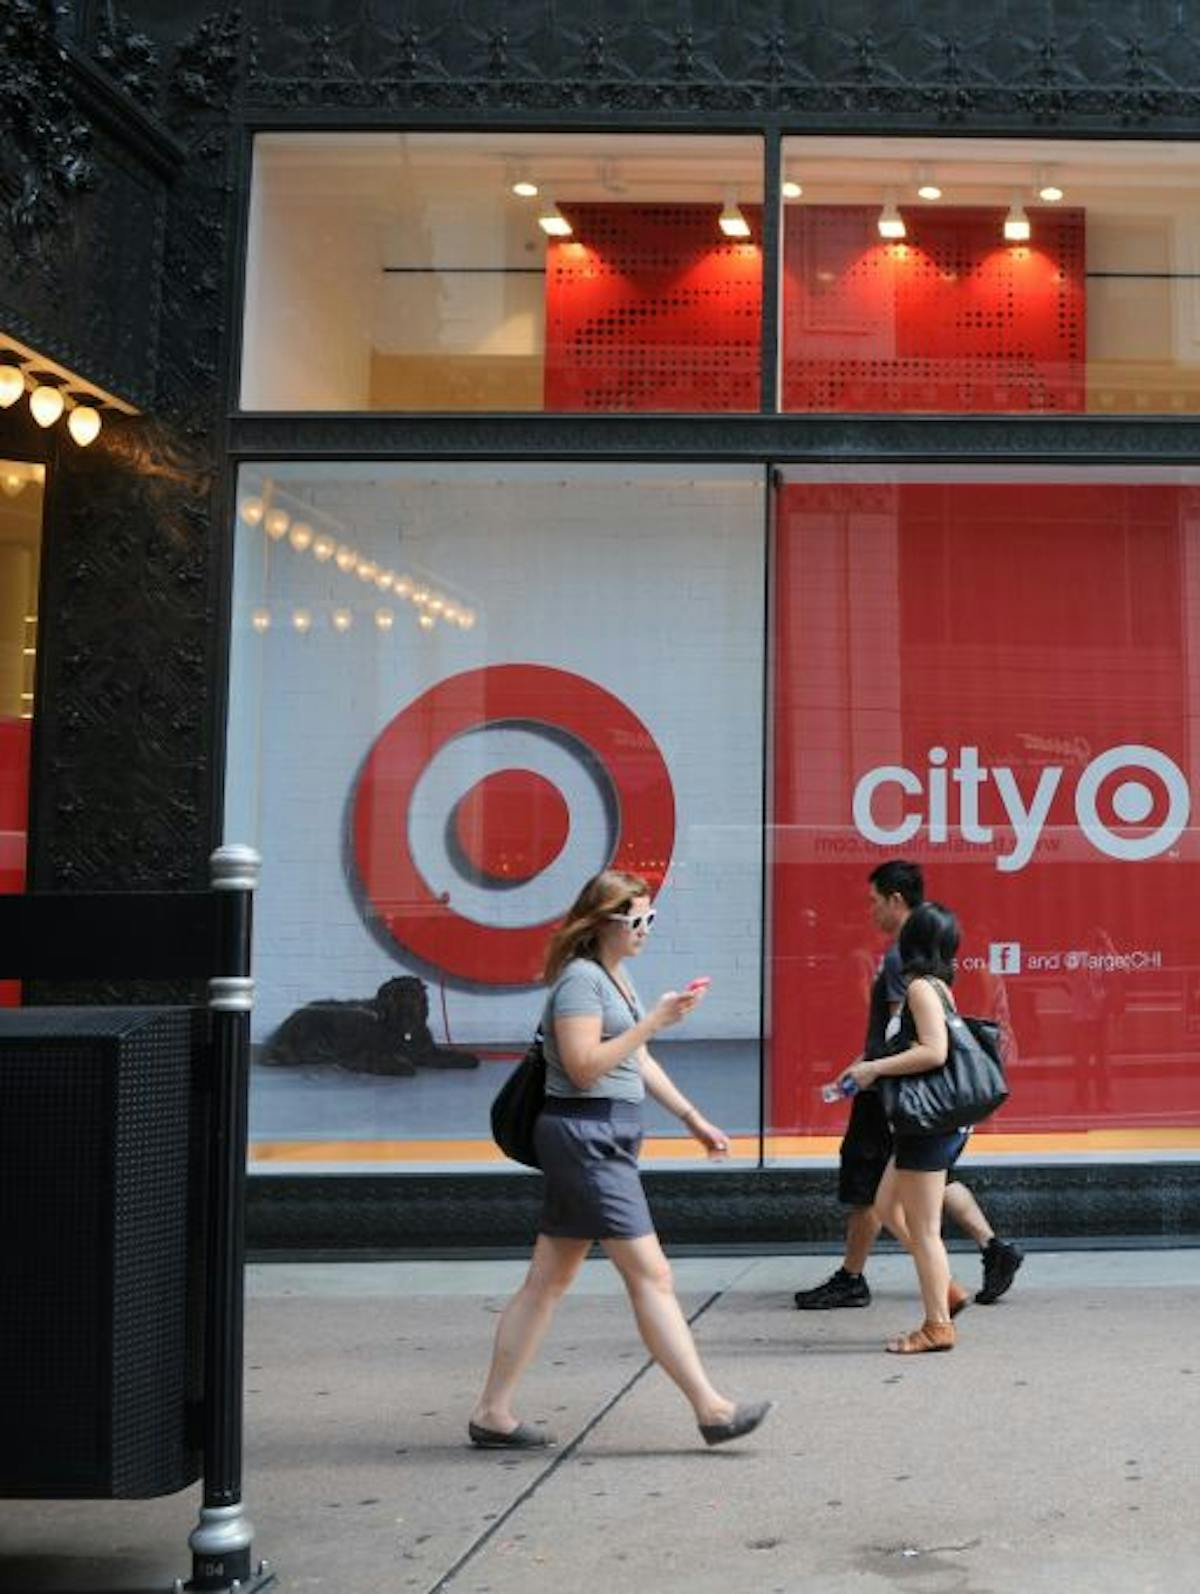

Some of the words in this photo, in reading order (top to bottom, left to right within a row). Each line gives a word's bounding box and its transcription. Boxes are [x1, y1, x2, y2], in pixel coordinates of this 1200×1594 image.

[853, 746, 1064, 871] city
[962, 957, 985, 970] on
[1028, 952, 1060, 970] and
